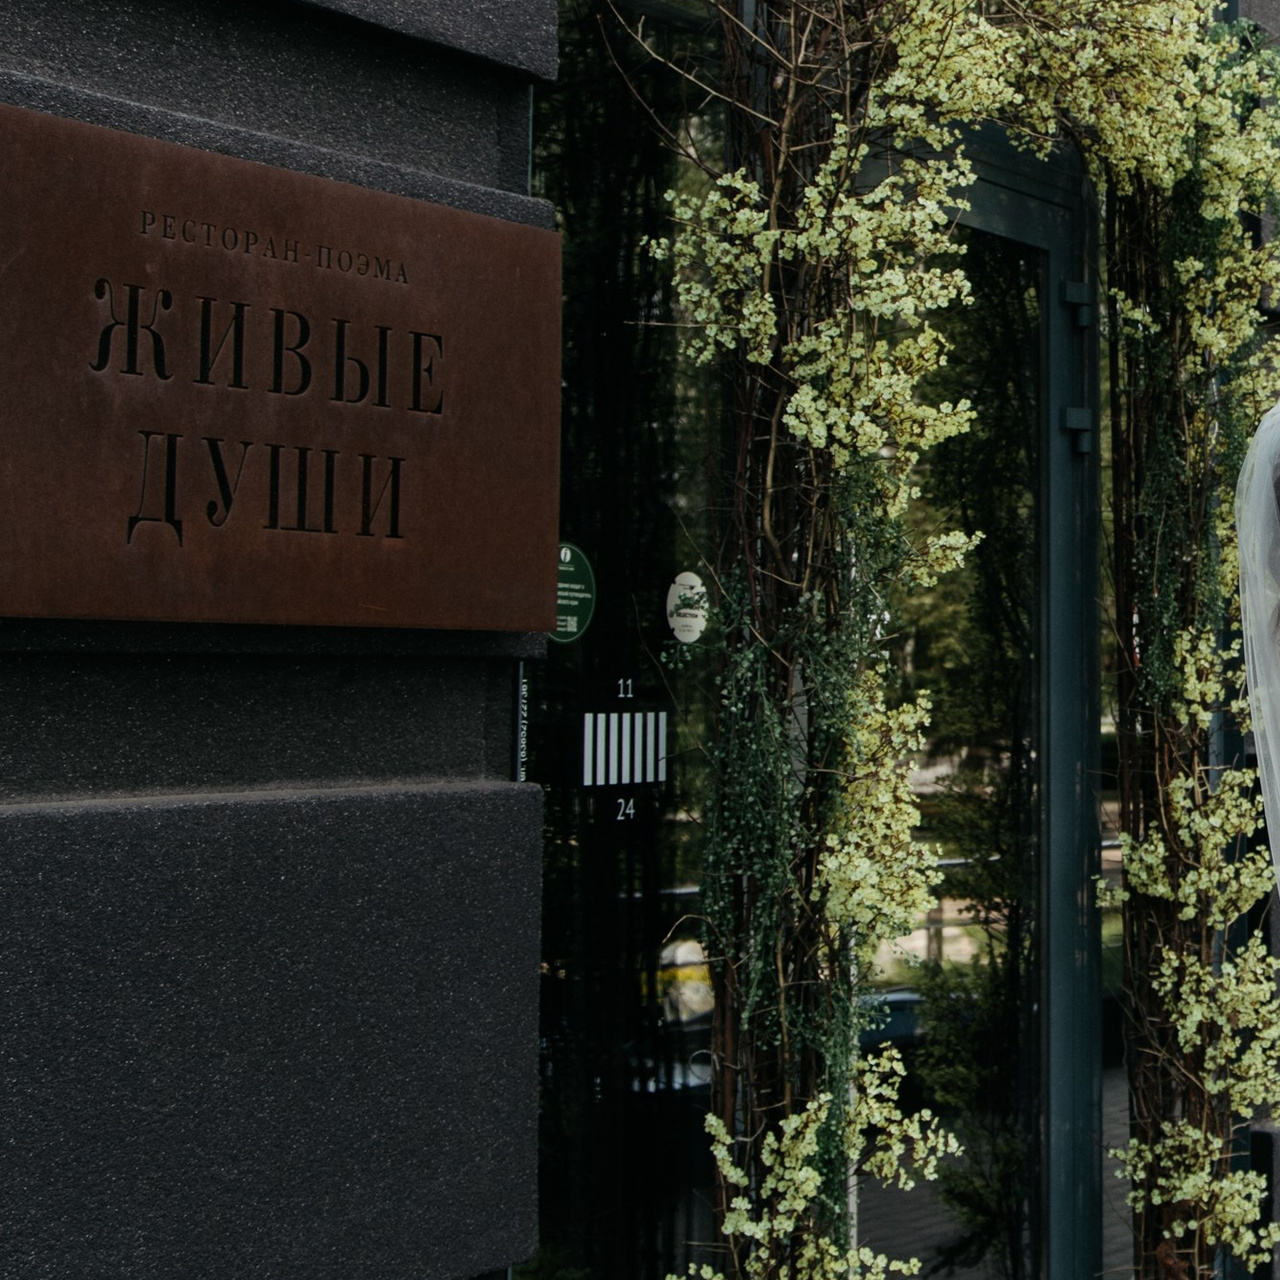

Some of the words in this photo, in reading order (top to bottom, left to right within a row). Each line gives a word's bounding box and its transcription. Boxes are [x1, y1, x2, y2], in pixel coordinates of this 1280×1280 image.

[140, 210, 410, 284] РЕСТОРАН-ПОЭМА
[88, 277, 445, 415] ЖИВЫЕ
[126, 429, 406, 548] ДУШИ
[618, 678, 634, 698] 11
[616, 798, 636, 820] 24
